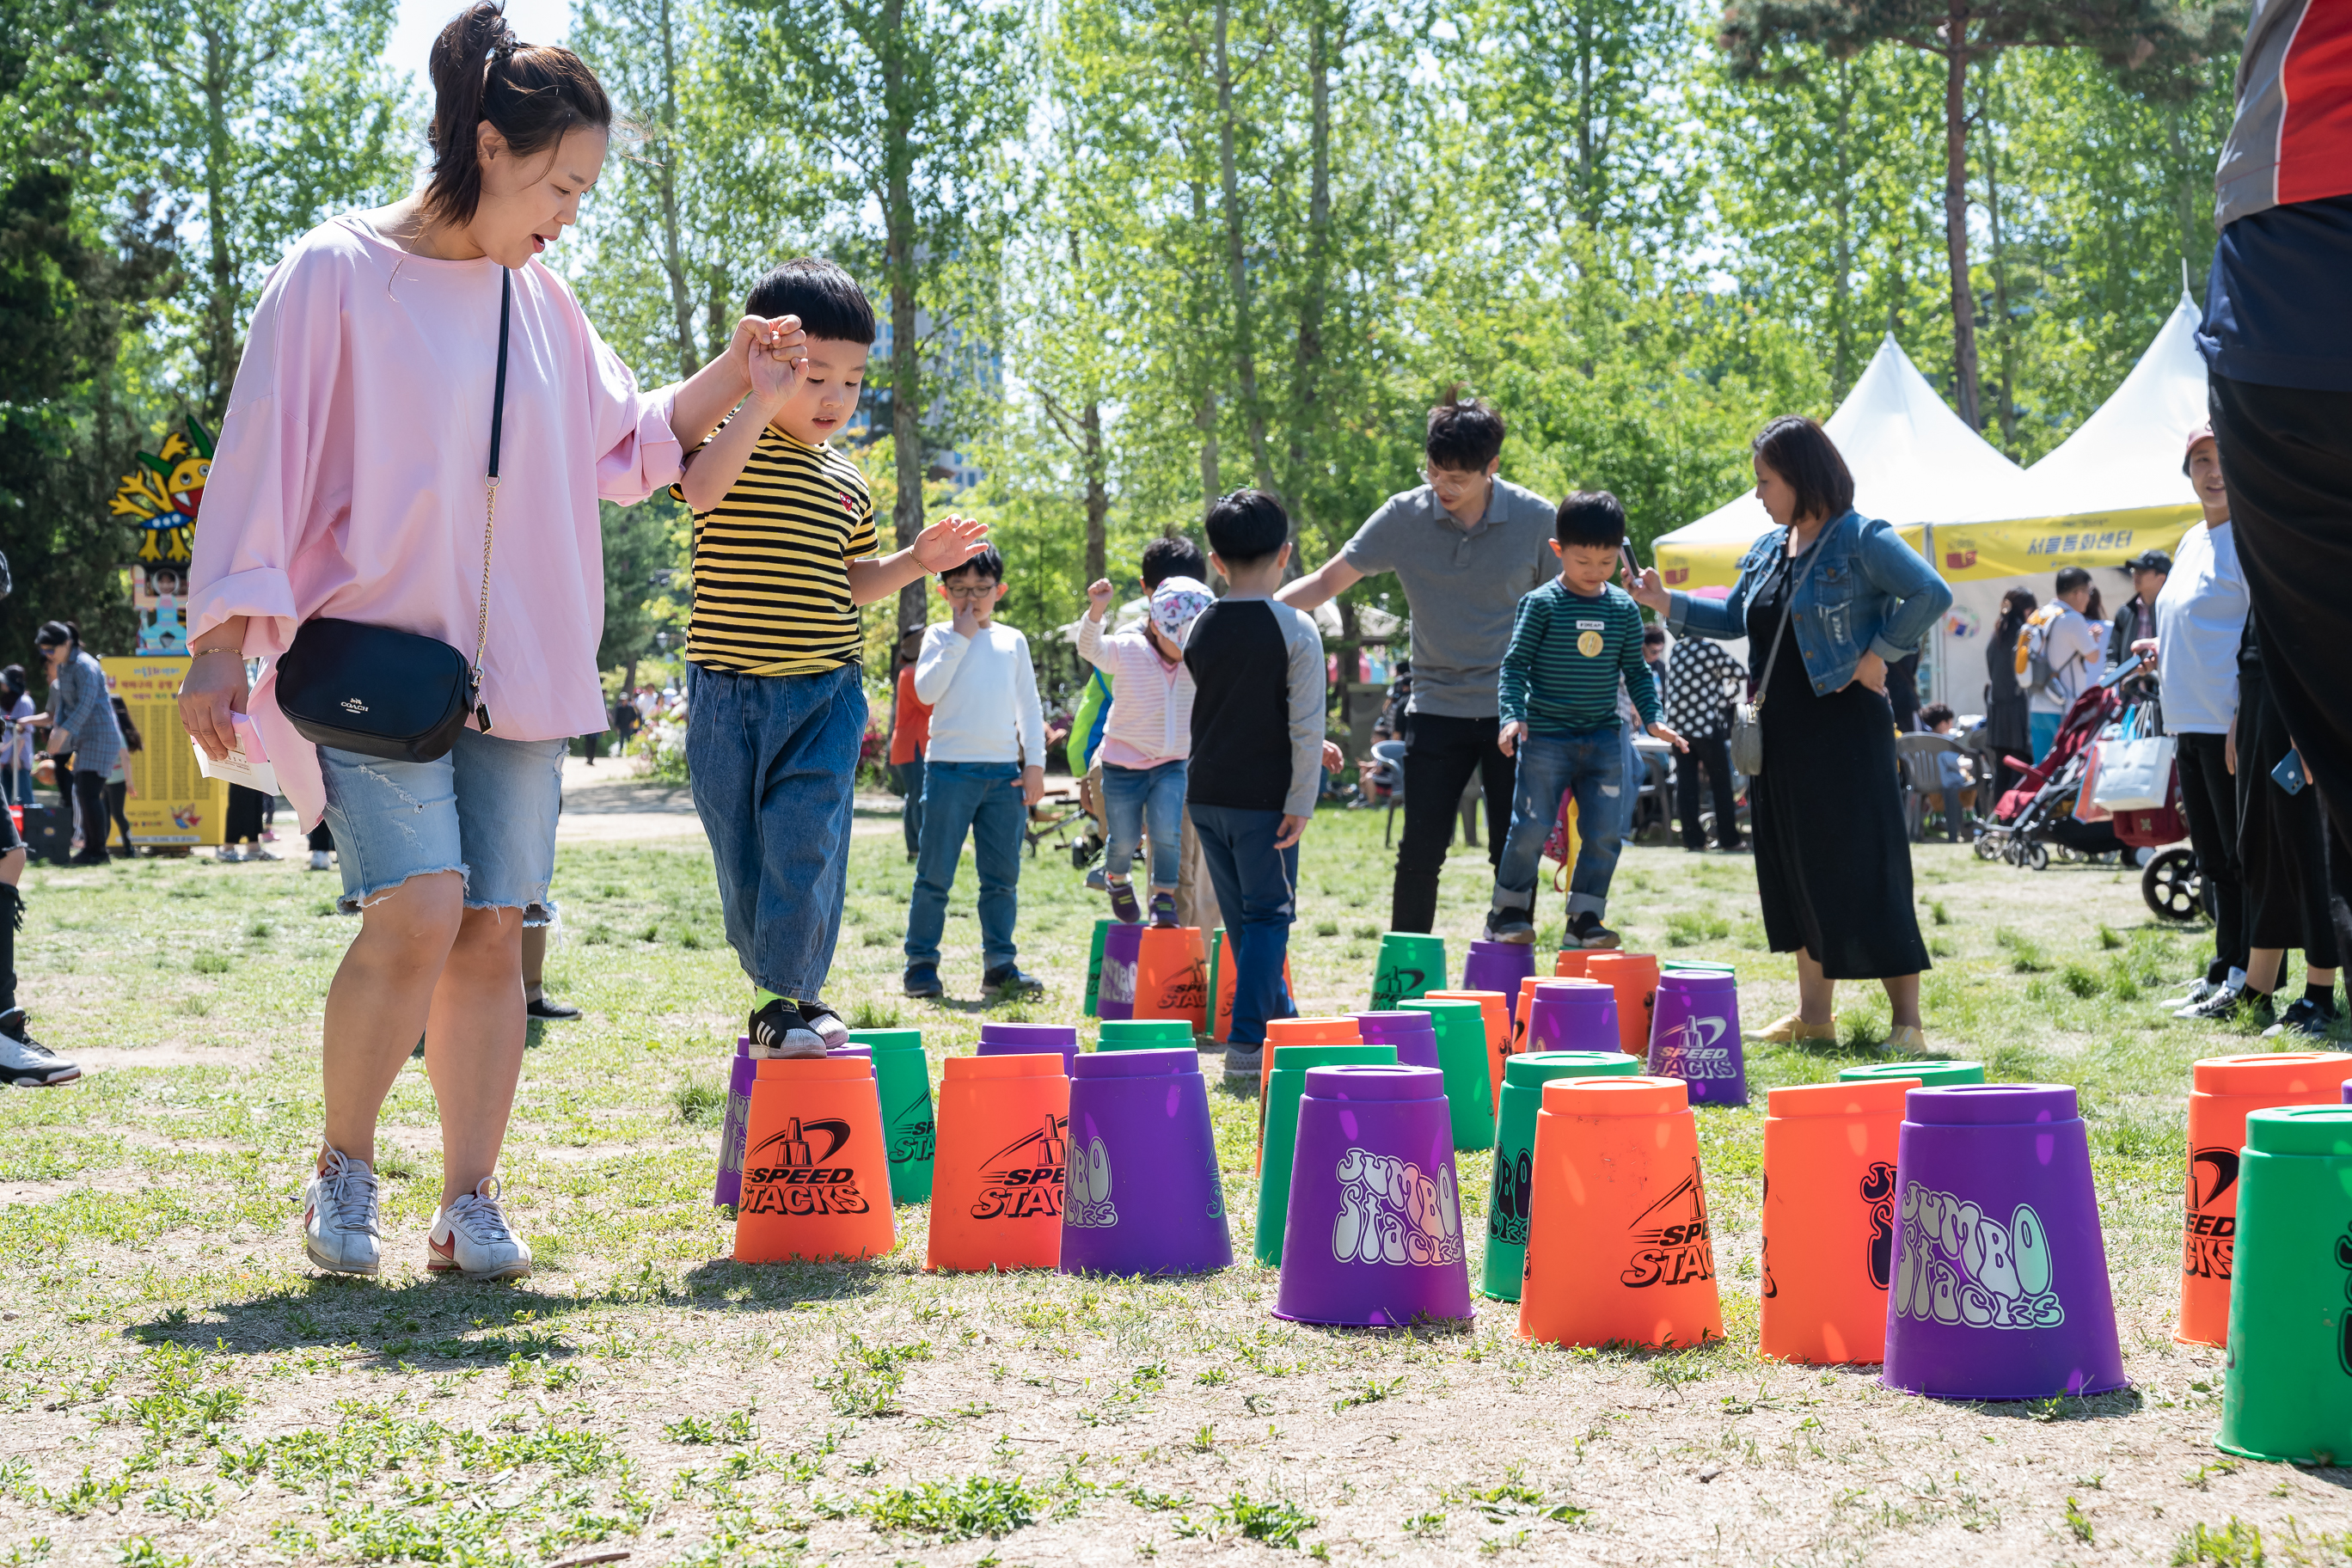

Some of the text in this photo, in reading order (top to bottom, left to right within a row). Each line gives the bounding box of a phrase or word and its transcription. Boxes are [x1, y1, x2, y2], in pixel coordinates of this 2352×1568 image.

[340, 701, 369, 712] COACH
[1661, 1046, 1728, 1059] SPEED
[1649, 1056, 1736, 1080] STACKS
[750, 1168, 854, 1185] SPEED
[739, 1184, 870, 1216] STACKS
